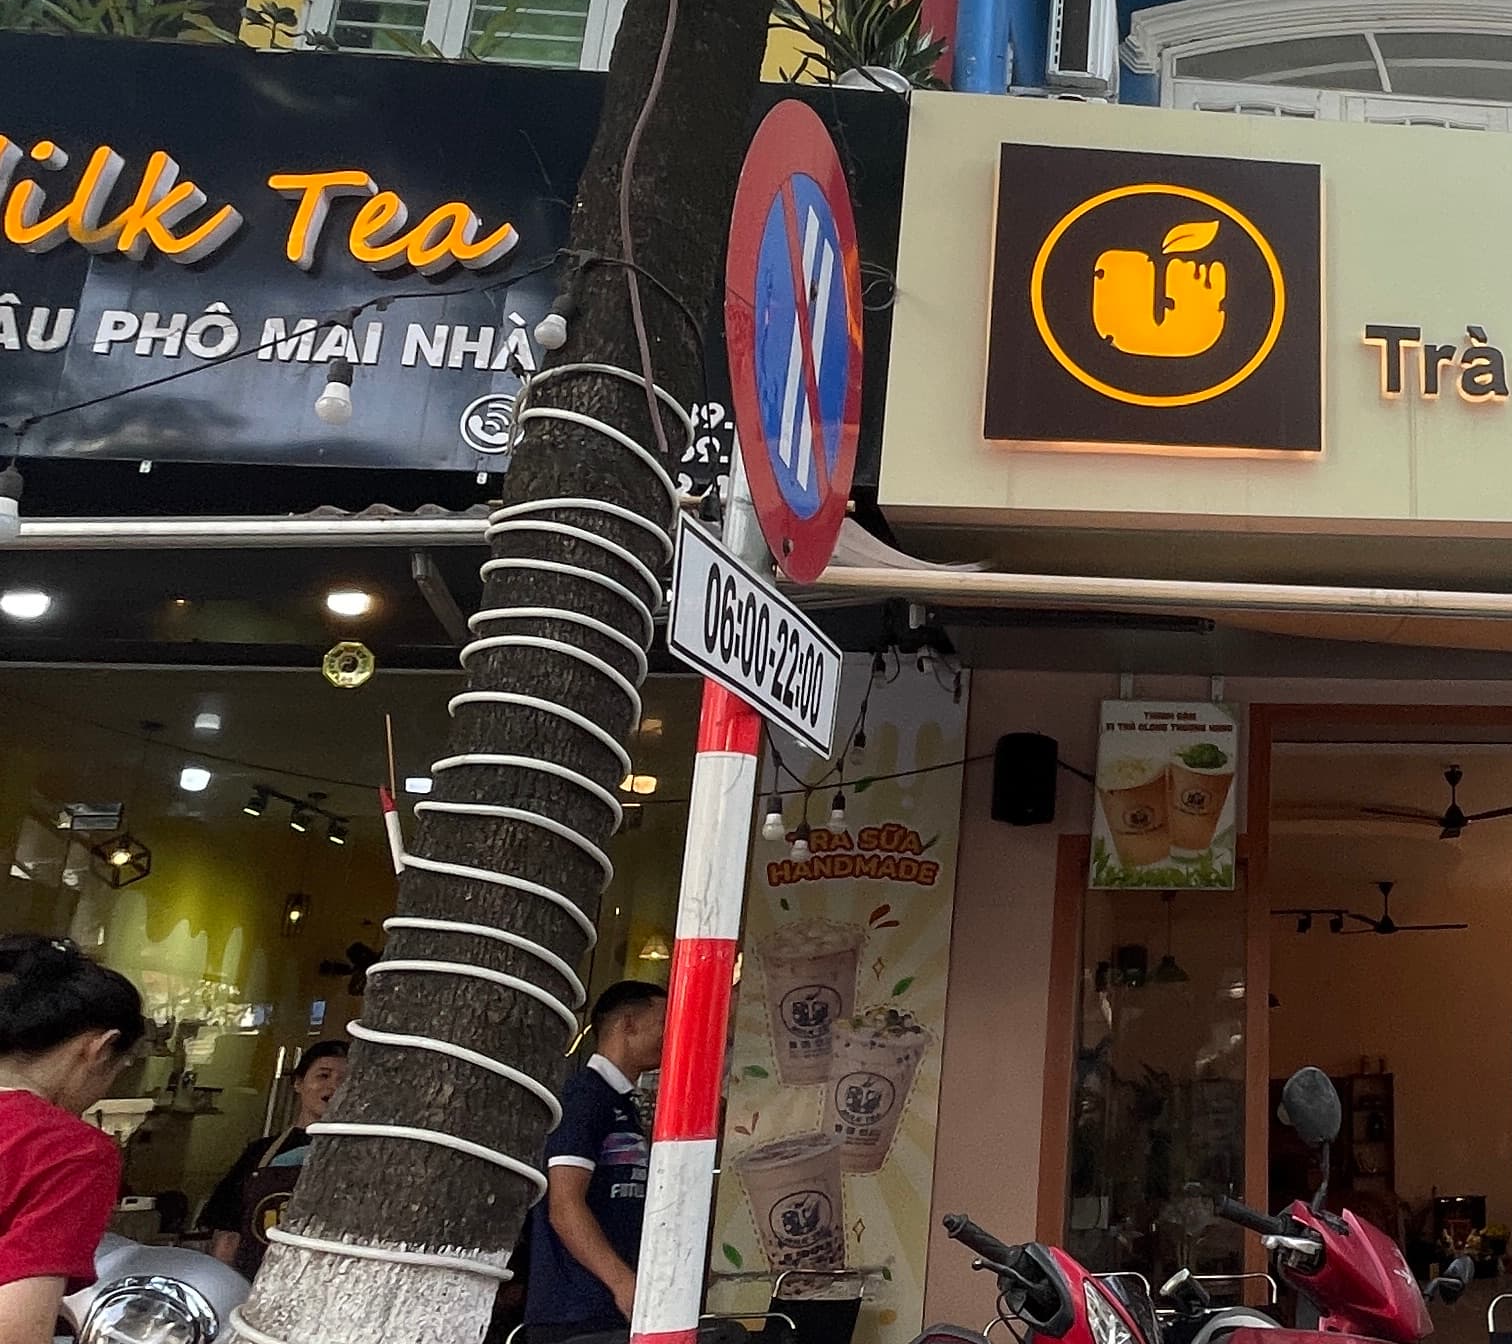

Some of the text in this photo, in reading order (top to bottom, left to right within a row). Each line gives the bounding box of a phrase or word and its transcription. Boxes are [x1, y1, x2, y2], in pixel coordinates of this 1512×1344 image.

[0, 133, 519, 271] ilk Tea
[93, 300, 241, 359] PHÔ
[257, 316, 385, 366] MAI
[401, 311, 537, 372] NHÀ
[1364, 322, 1510, 404] Trà
[704, 562, 824, 729] 06:00-22:00
[766, 853, 940, 888] HANDMADE
